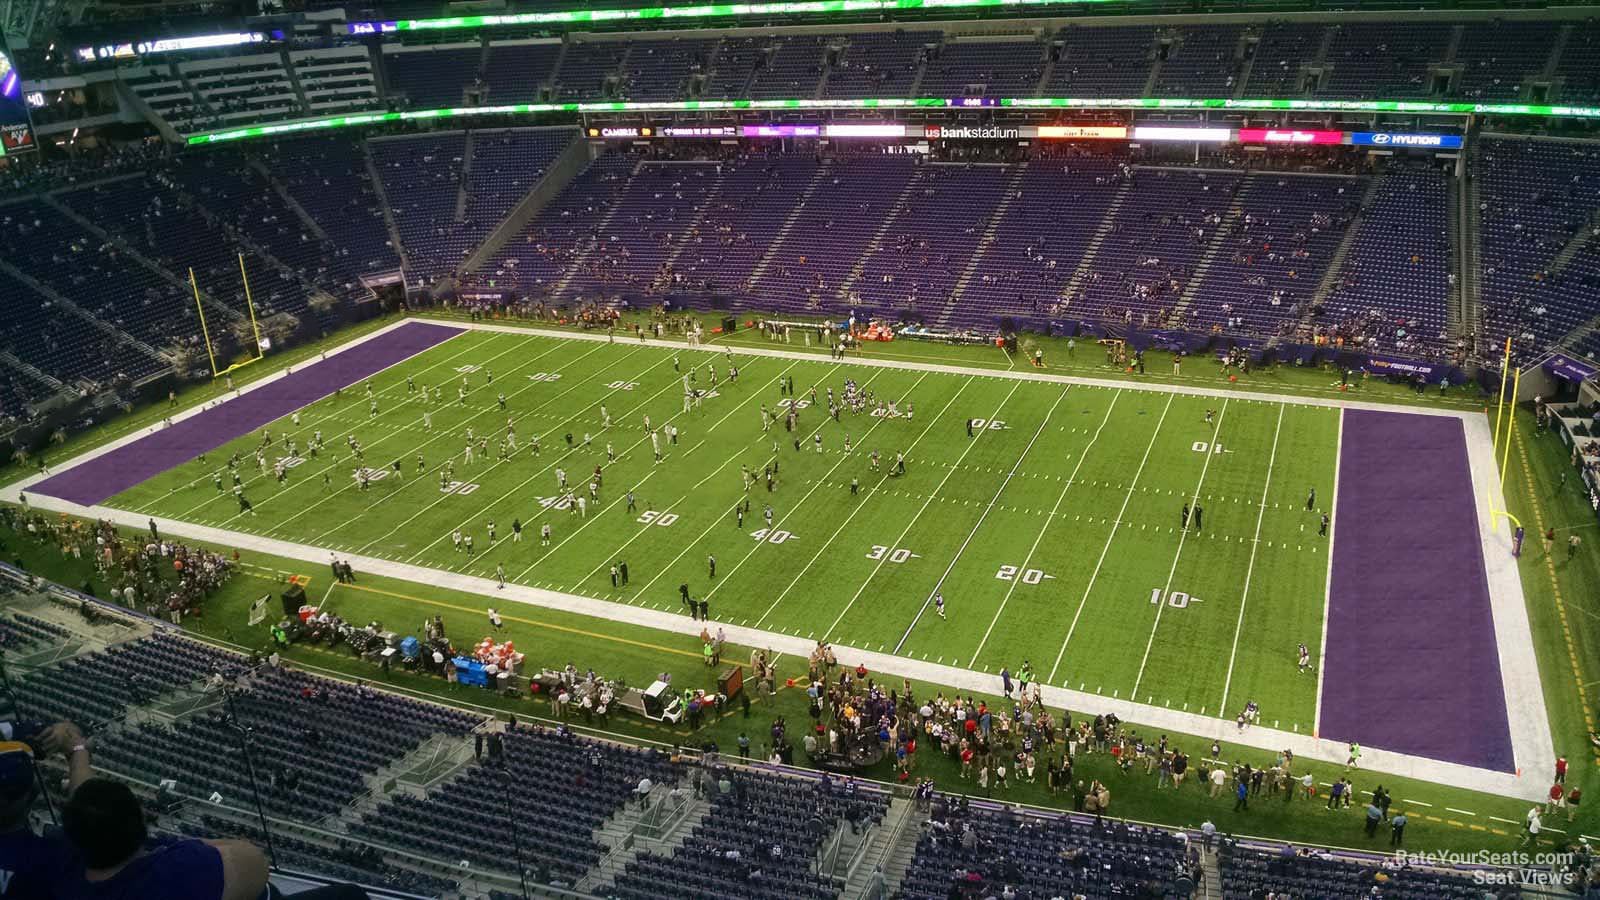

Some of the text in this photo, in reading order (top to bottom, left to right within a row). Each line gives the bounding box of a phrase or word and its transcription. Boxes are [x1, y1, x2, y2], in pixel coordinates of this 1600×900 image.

[601, 127, 638, 137] CAMBRIA
[1391, 134, 1441, 145] HYUNDAI
[636, 510, 680, 527] 50
[750, 527, 793, 545] 40
[865, 544, 914, 564] 30
[994, 564, 1045, 585] 20
[1150, 587, 1190, 609] 10
